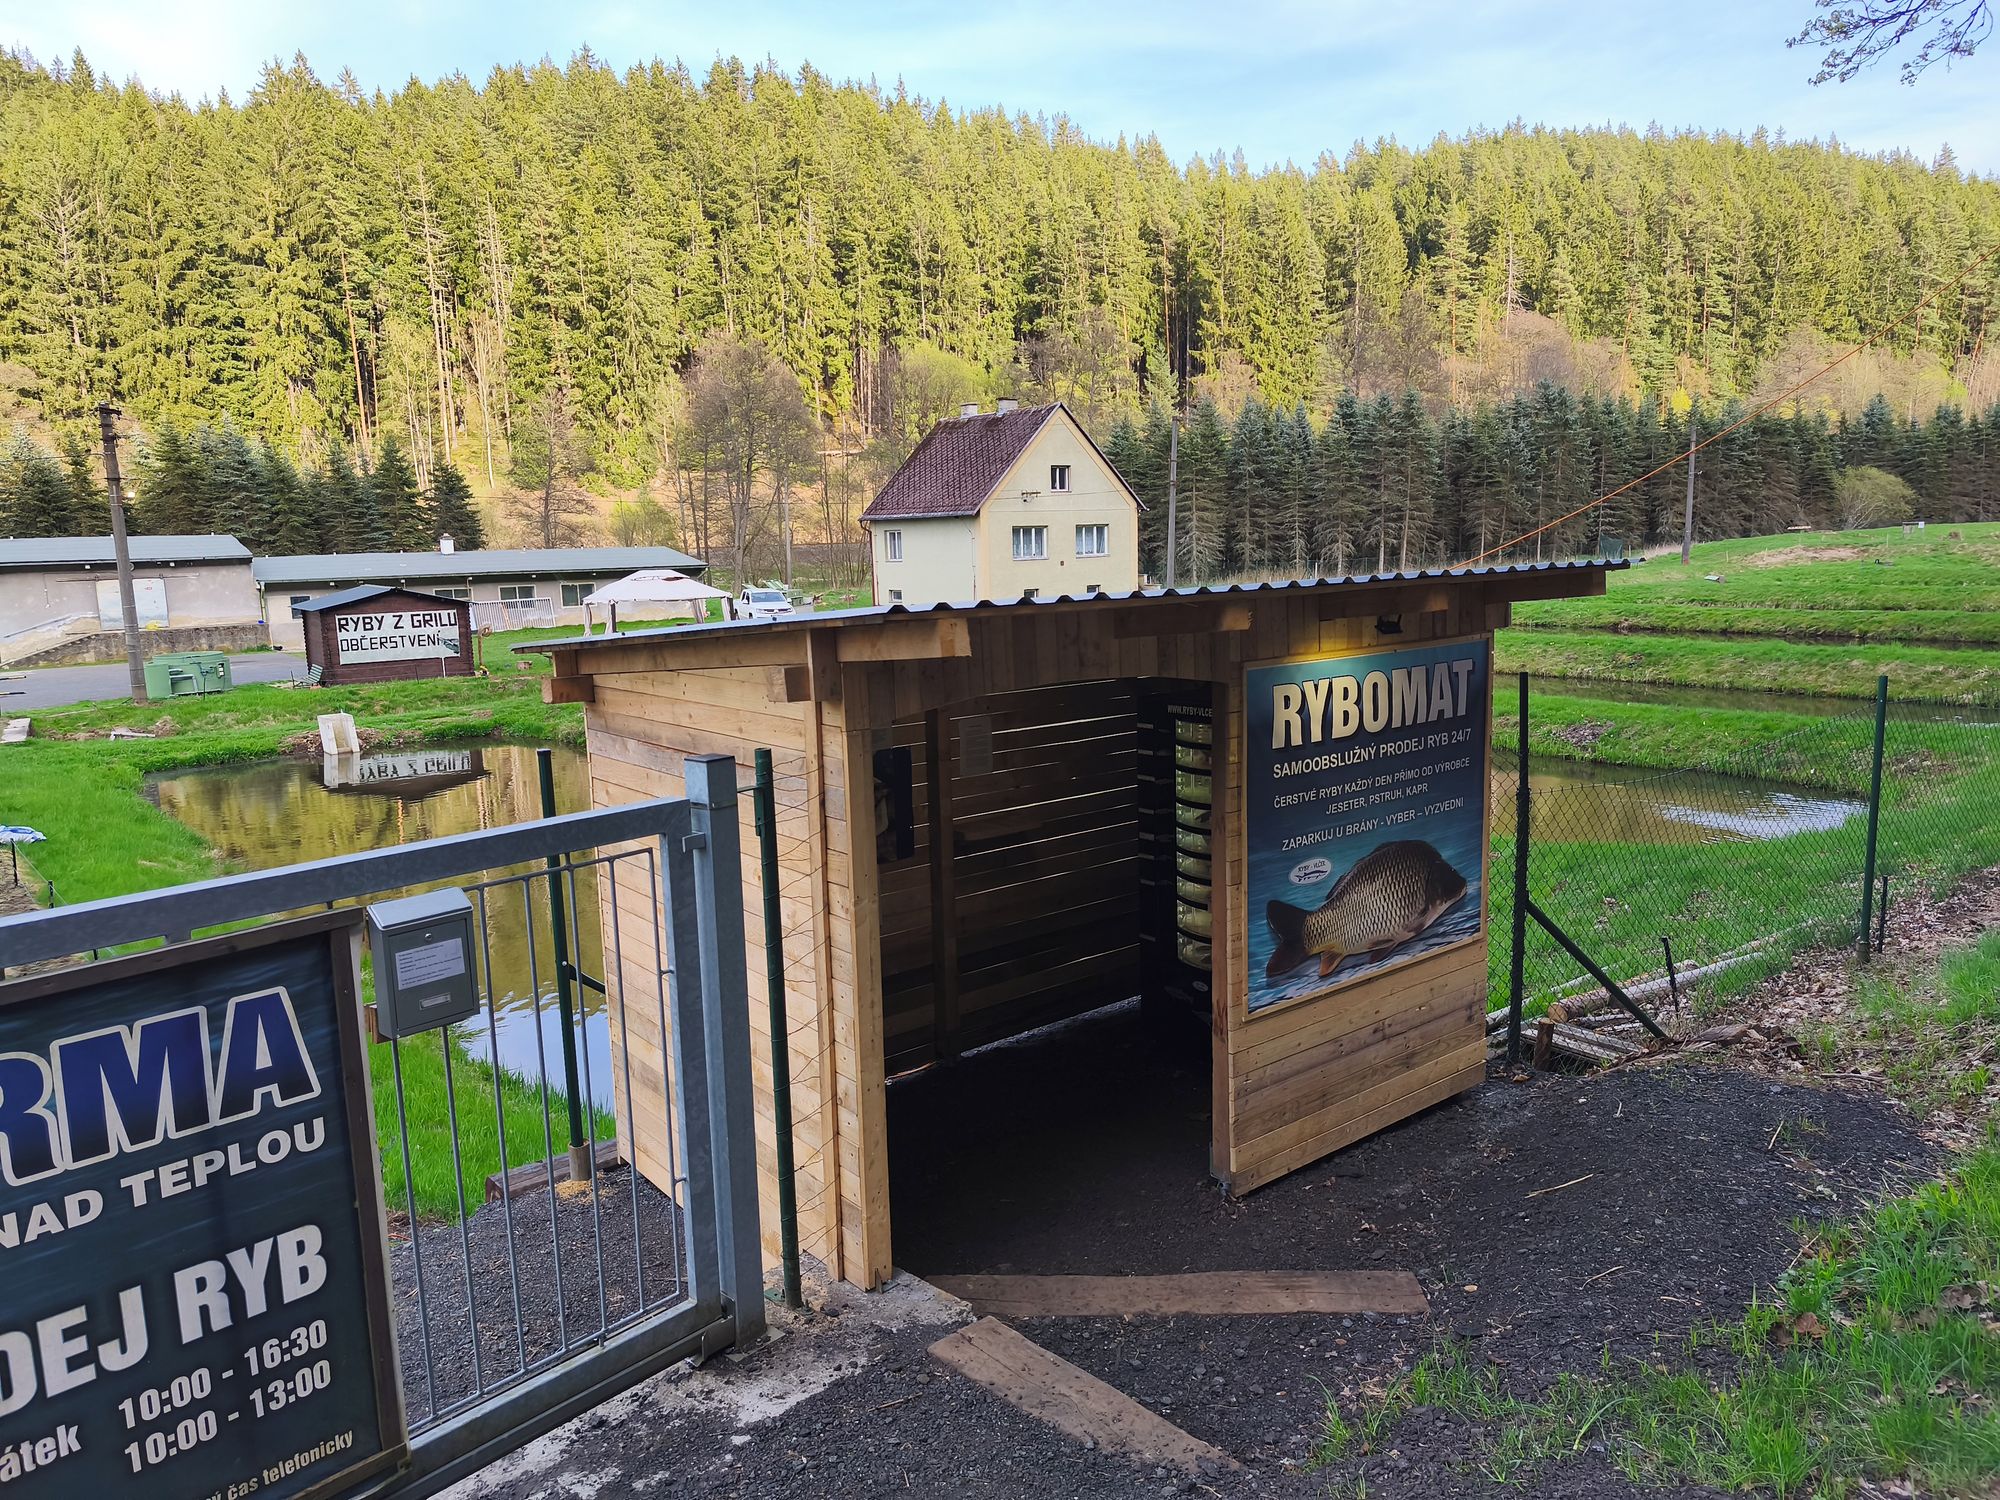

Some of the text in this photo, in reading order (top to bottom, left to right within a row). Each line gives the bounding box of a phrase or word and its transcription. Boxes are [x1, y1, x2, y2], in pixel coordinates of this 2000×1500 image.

[337, 612, 457, 633] RYBY Z GRILU
[1272, 659, 1473, 749] RYBOMAT
[1273, 728, 1472, 778] SAMOOBSLUŽNÝ PRODEJ RYB 24/7
[1274, 757, 1470, 808] ČERSTVÉ RYBY KAŽDÝ DEN PŘÍMO OD VÝROBCE
[1282, 829, 1333, 851] ZAPARKUJ
[1336, 827, 1344, 838] U
[1346, 818, 1378, 836] BRÁNY
[1385, 809, 1416, 826] VYBER
[1424, 797, 1464, 816] VYZVEDNI
[1326, 783, 1428, 814] JESETER, PSTRUH, KAPR
[0, 986, 322, 1187] RMA
[120, 1117, 326, 1208] TEPLOU
[173, 1224, 328, 1345] RYB
[0, 1424, 82, 1482] átek
[118, 1368, 212, 1430] 10:00
[244, 1320, 328, 1376] 16:30
[124, 1410, 218, 1473] 10:00
[249, 1360, 331, 1418] 13:00
[227, 1430, 353, 1500] čas telefonicky
